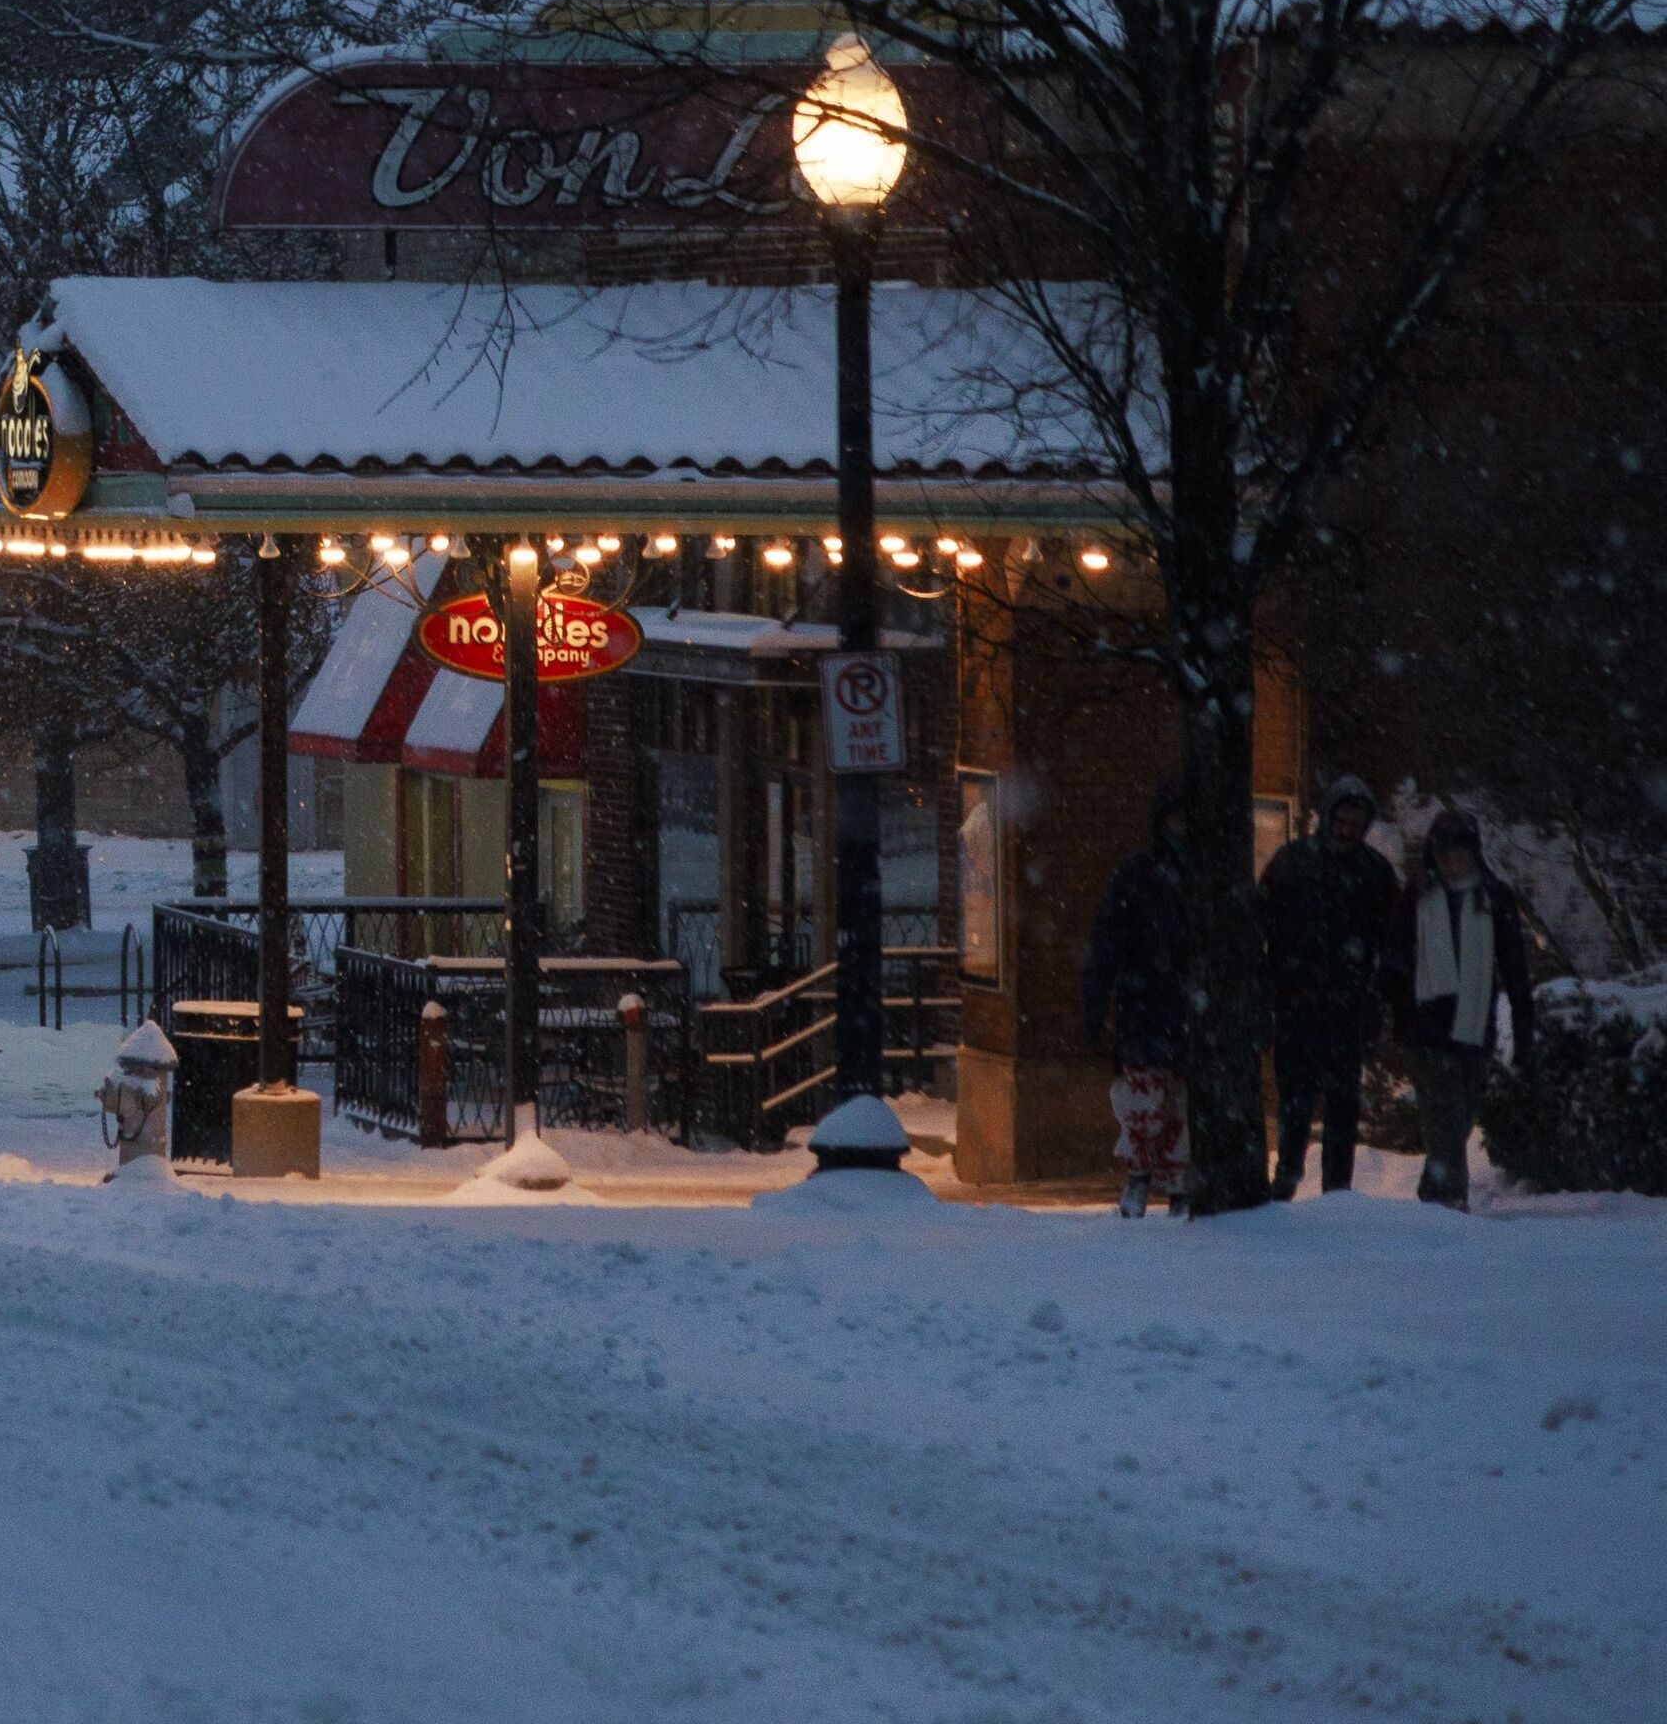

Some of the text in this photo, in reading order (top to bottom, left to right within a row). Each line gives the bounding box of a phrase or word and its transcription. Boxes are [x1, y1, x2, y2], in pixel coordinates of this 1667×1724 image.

[333, 86, 657, 207] Von
[449, 601, 609, 648] nodles
[849, 721, 883, 738] ANY
[848, 742, 887, 763] TIME
